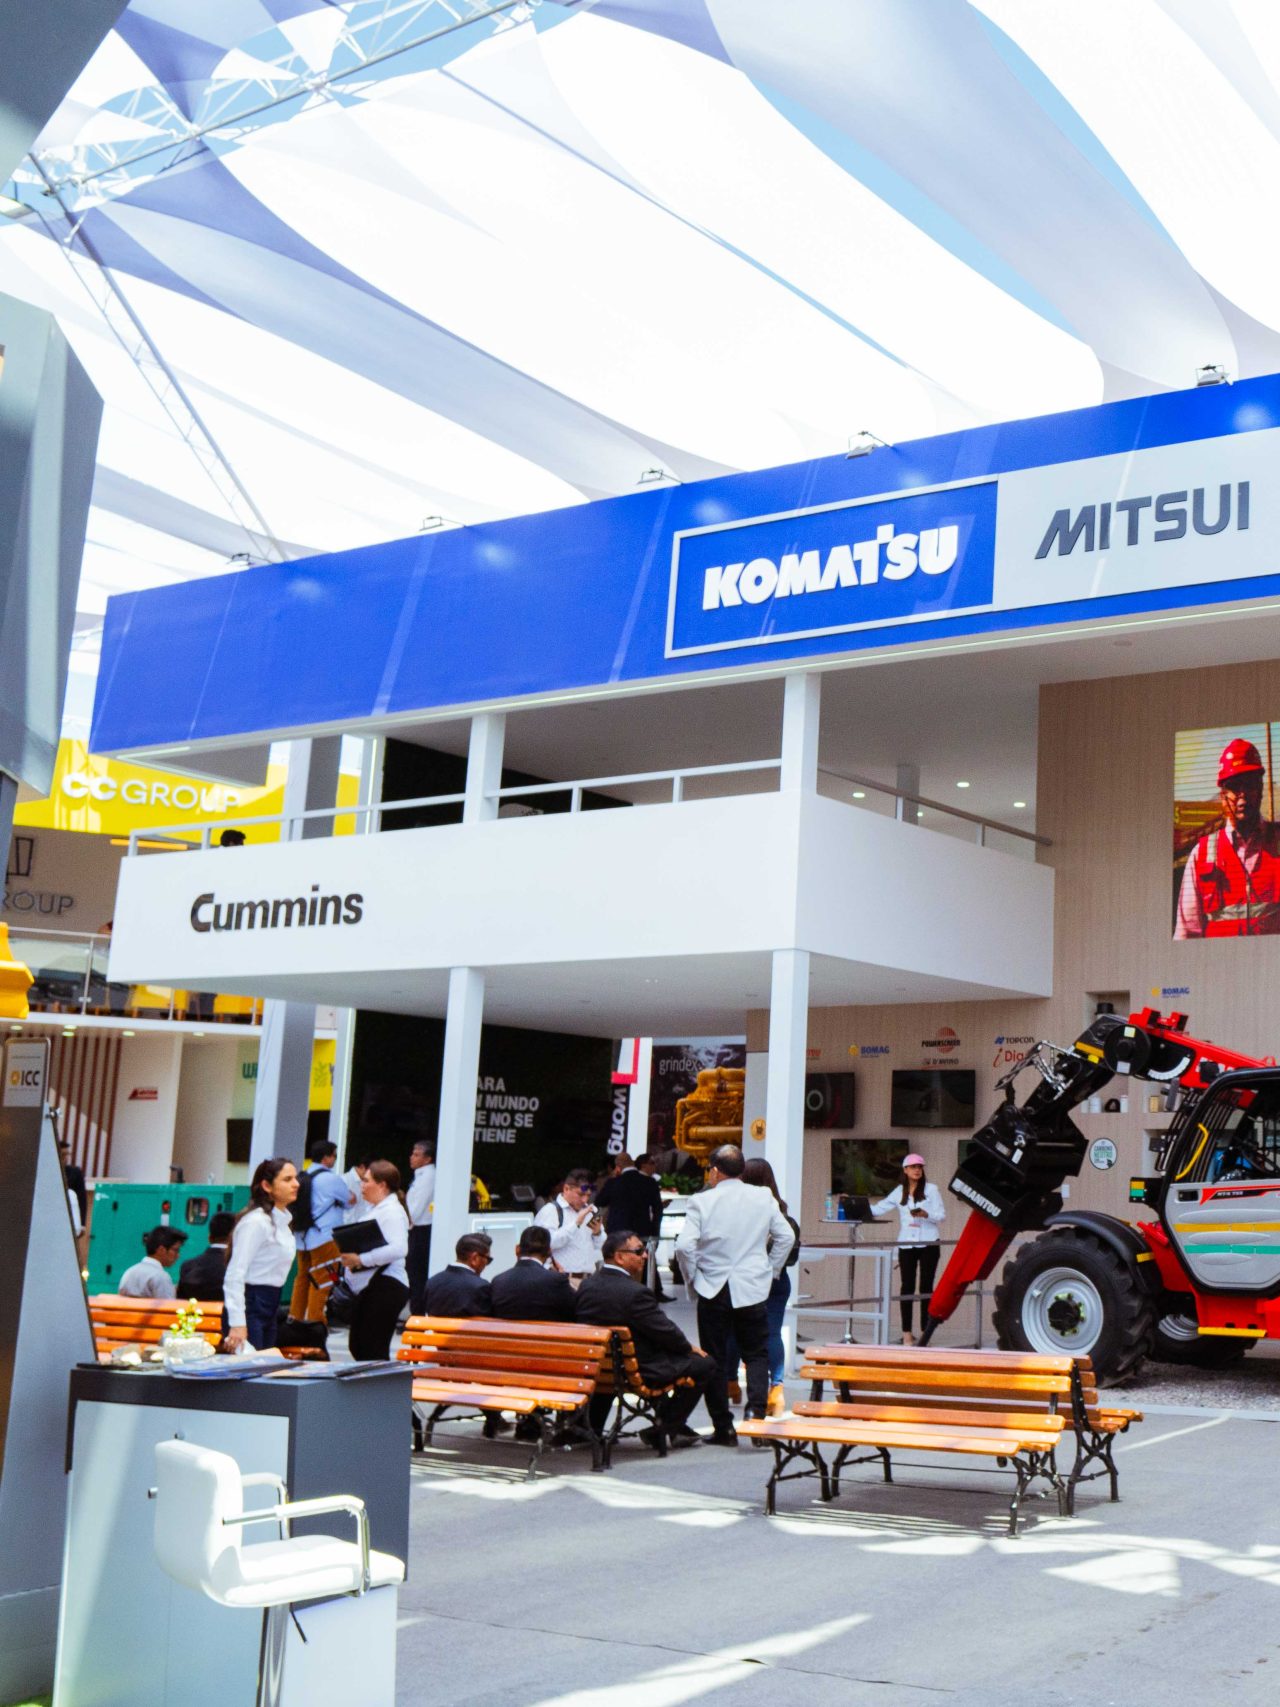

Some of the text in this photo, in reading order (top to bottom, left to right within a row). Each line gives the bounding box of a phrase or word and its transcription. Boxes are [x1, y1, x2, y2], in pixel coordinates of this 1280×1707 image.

[1034, 481, 1250, 560] MITSUI
[702, 523, 959, 611] KOMATSU
[121, 779, 241, 813] GROUP
[190, 884, 364, 933] Cummins
[1162, 987, 1190, 995] BOMAG
[861, 1045, 890, 1054] BOMAG
[658, 1056, 699, 1075] grindex
[21, 1070, 40, 1087] ICC
[477, 1076, 506, 1093] ARA
[485, 1094, 540, 1112] MUNDO
[490, 1112, 511, 1127] NO
[514, 1113, 534, 1128] SE
[607, 1087, 628, 1156] wong
[475, 1127, 517, 1143] TIENE
[961, 1185, 1002, 1217] MANITOU
